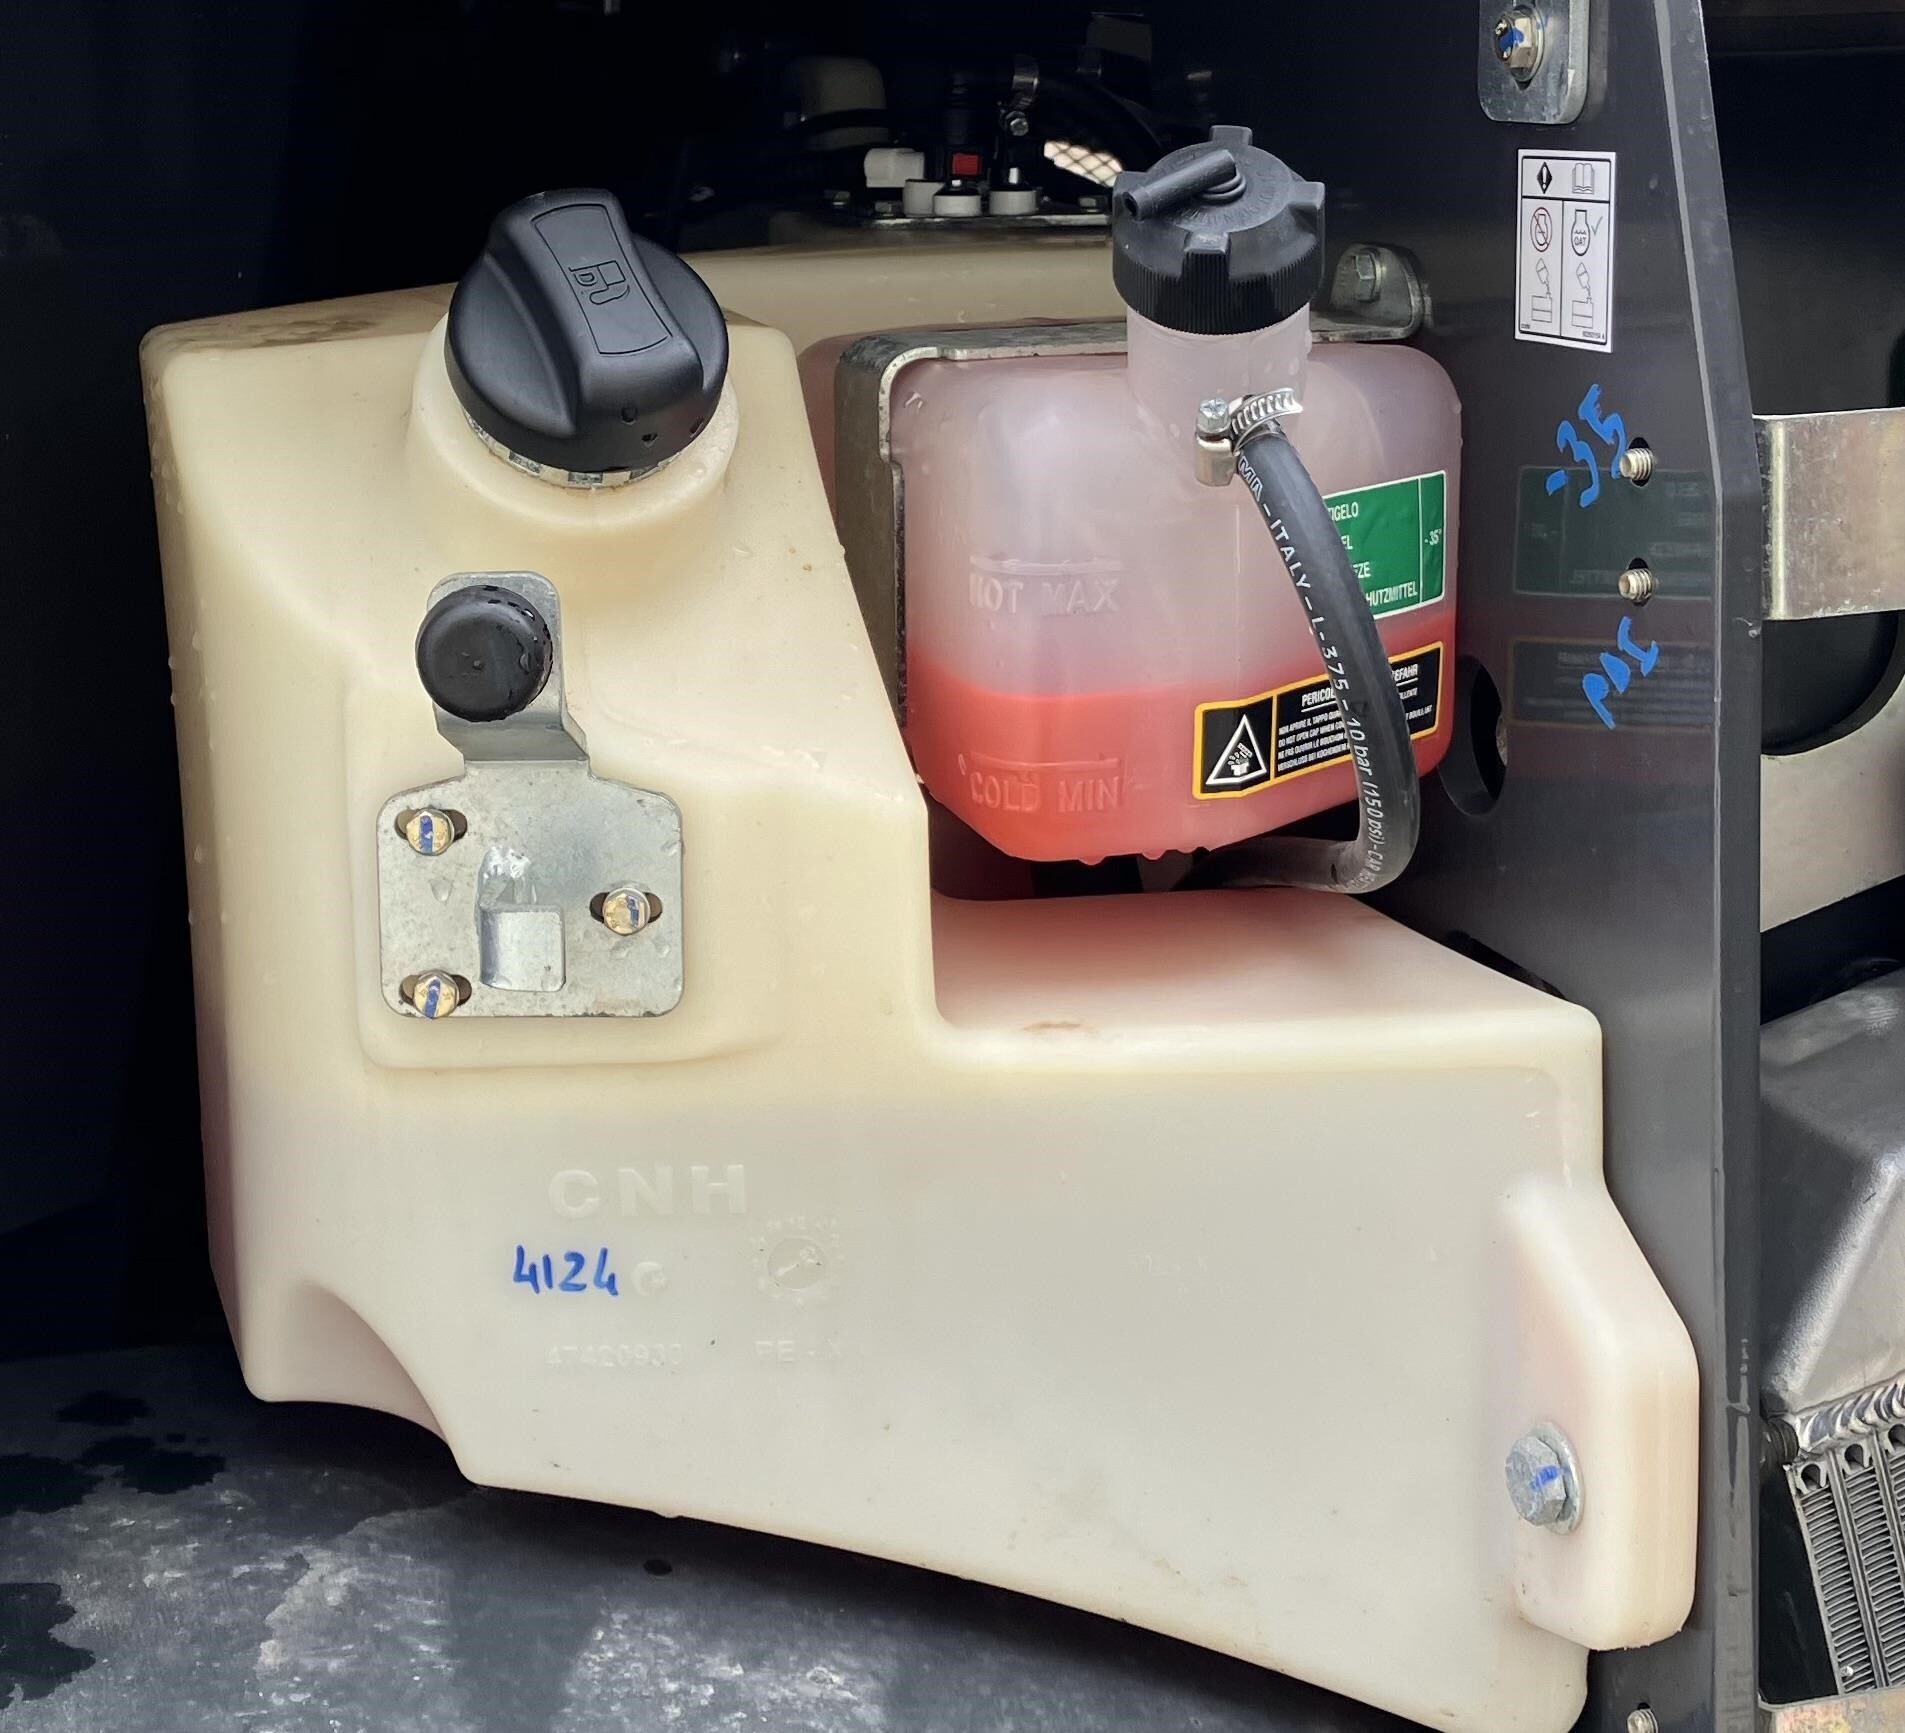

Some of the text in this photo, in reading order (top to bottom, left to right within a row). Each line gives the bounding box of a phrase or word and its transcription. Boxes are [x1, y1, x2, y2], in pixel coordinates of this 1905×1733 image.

[1237, 455, 1264, 502] MA
[1269, 518, 1312, 589] ITALY
[968, 572, 1121, 616] HOT MAX
[1365, 580, 1418, 607] HUTZMITTEL
[1301, 687, 1337, 708] PERICOL
[968, 771, 1121, 813] COLD MIN
[548, 1163, 747, 1218] CNH
[513, 1244, 619, 1297] 4124
